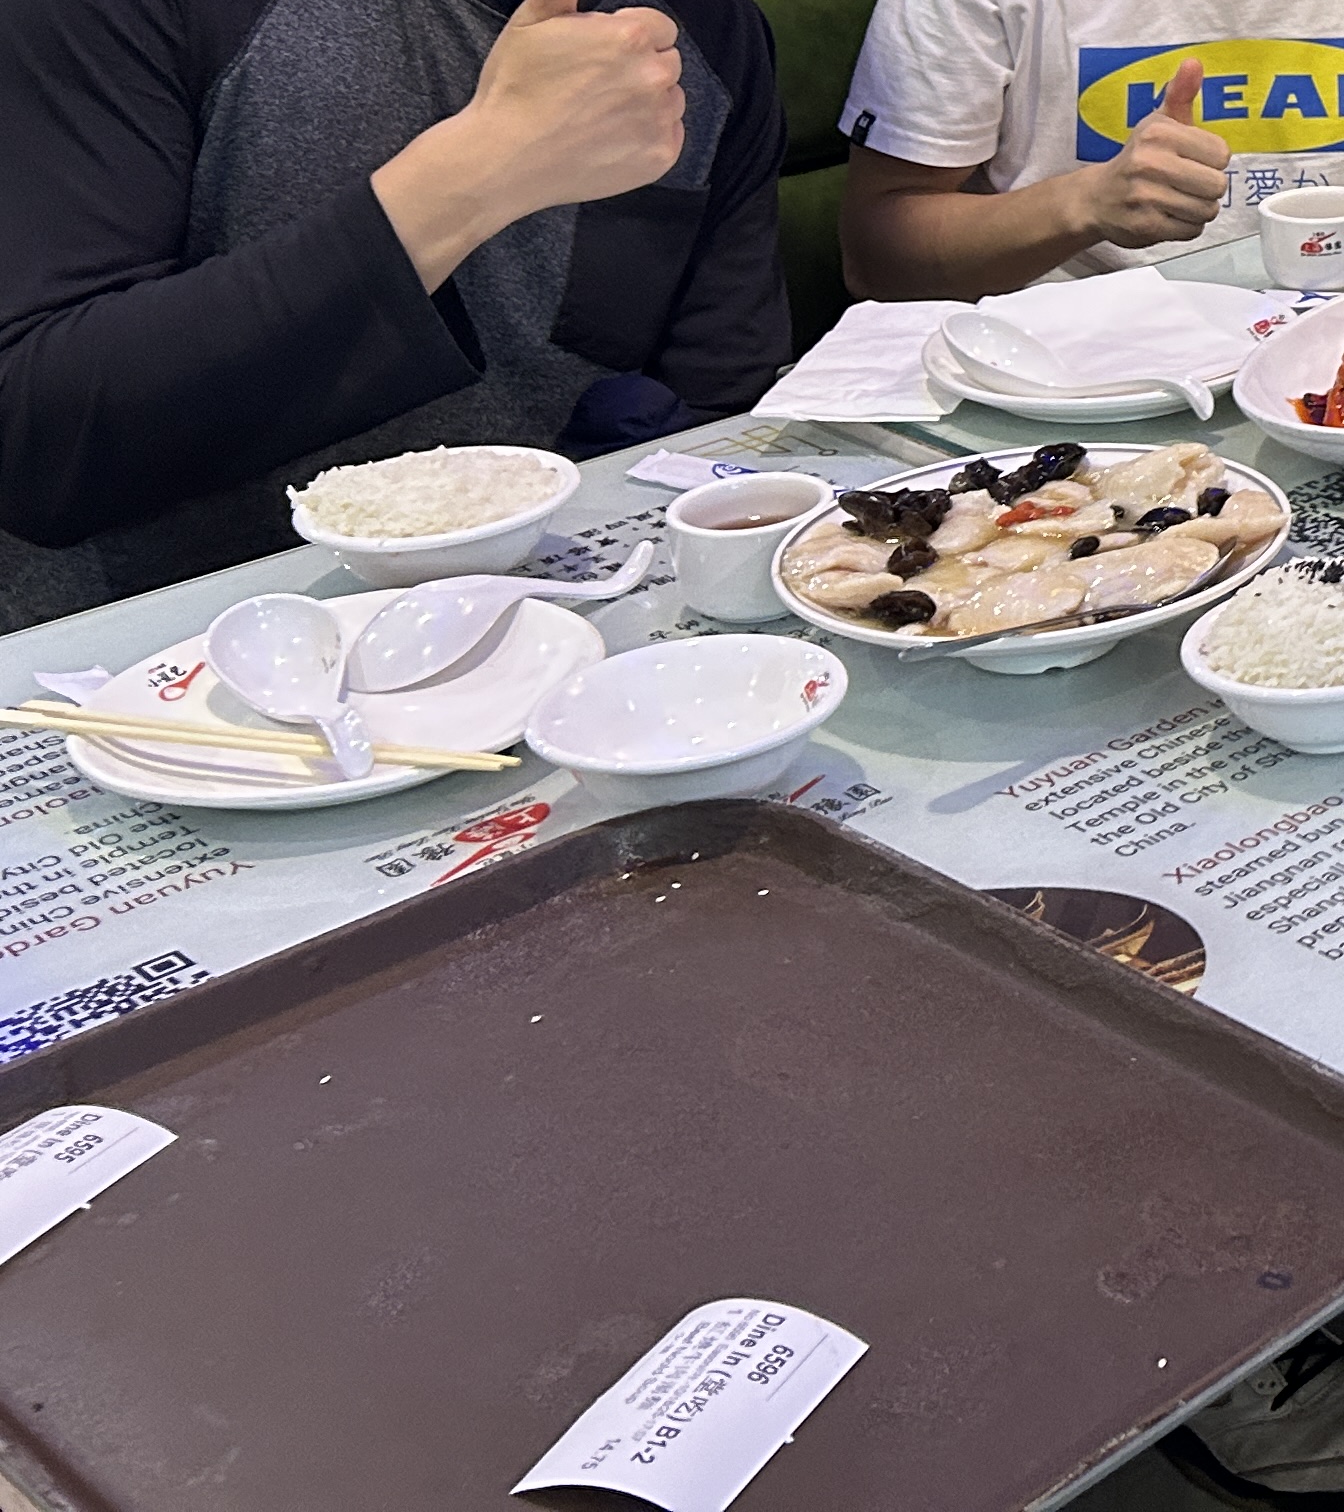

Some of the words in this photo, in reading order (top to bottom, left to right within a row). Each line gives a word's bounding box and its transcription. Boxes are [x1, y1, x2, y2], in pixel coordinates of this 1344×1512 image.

[993, 749, 1108, 799] Yuyuan
[1107, 705, 1208, 752] Garden
[1024, 757, 1138, 812] extensive
[1136, 714, 1231, 759] Chinese
[1047, 774, 1145, 820] located
[1141, 738, 1224, 779] beside
[1219, 724, 1255, 743] th
[1064, 789, 1162, 834] Temple
[1157, 777, 1187, 793] in
[1185, 757, 1229, 779] the
[1089, 823, 1136, 847] the
[1134, 801, 1181, 826] Old
[1178, 778, 1231, 806] City
[1229, 764, 1258, 783] of
[68, 832, 123, 858] Old
[128, 812, 182, 834] the
[1114, 821, 1197, 858] China.
[1162, 795, 1344, 885] Xiaolongbao
[1, 854, 62, 881] City
[79, 824, 201, 870] Temple
[87, 838, 209, 887] located
[1194, 839, 1302, 897] steamed
[42, 867, 76, 882] in
[80, 846, 231, 906] extensive
[108, 860, 256, 916] Yuyuan
[1222, 849, 1333, 910] Jiangnan
[56, 1113, 104, 1137] Dine
[54, 1134, 104, 1164] 6595
[739, 1312, 787, 1348] Dine
[722, 1353, 751, 1367] In
[747, 1344, 795, 1386] 6596
[666, 1368, 733, 1423] (堂吃)
[630, 1424, 682, 1466] B1-2
